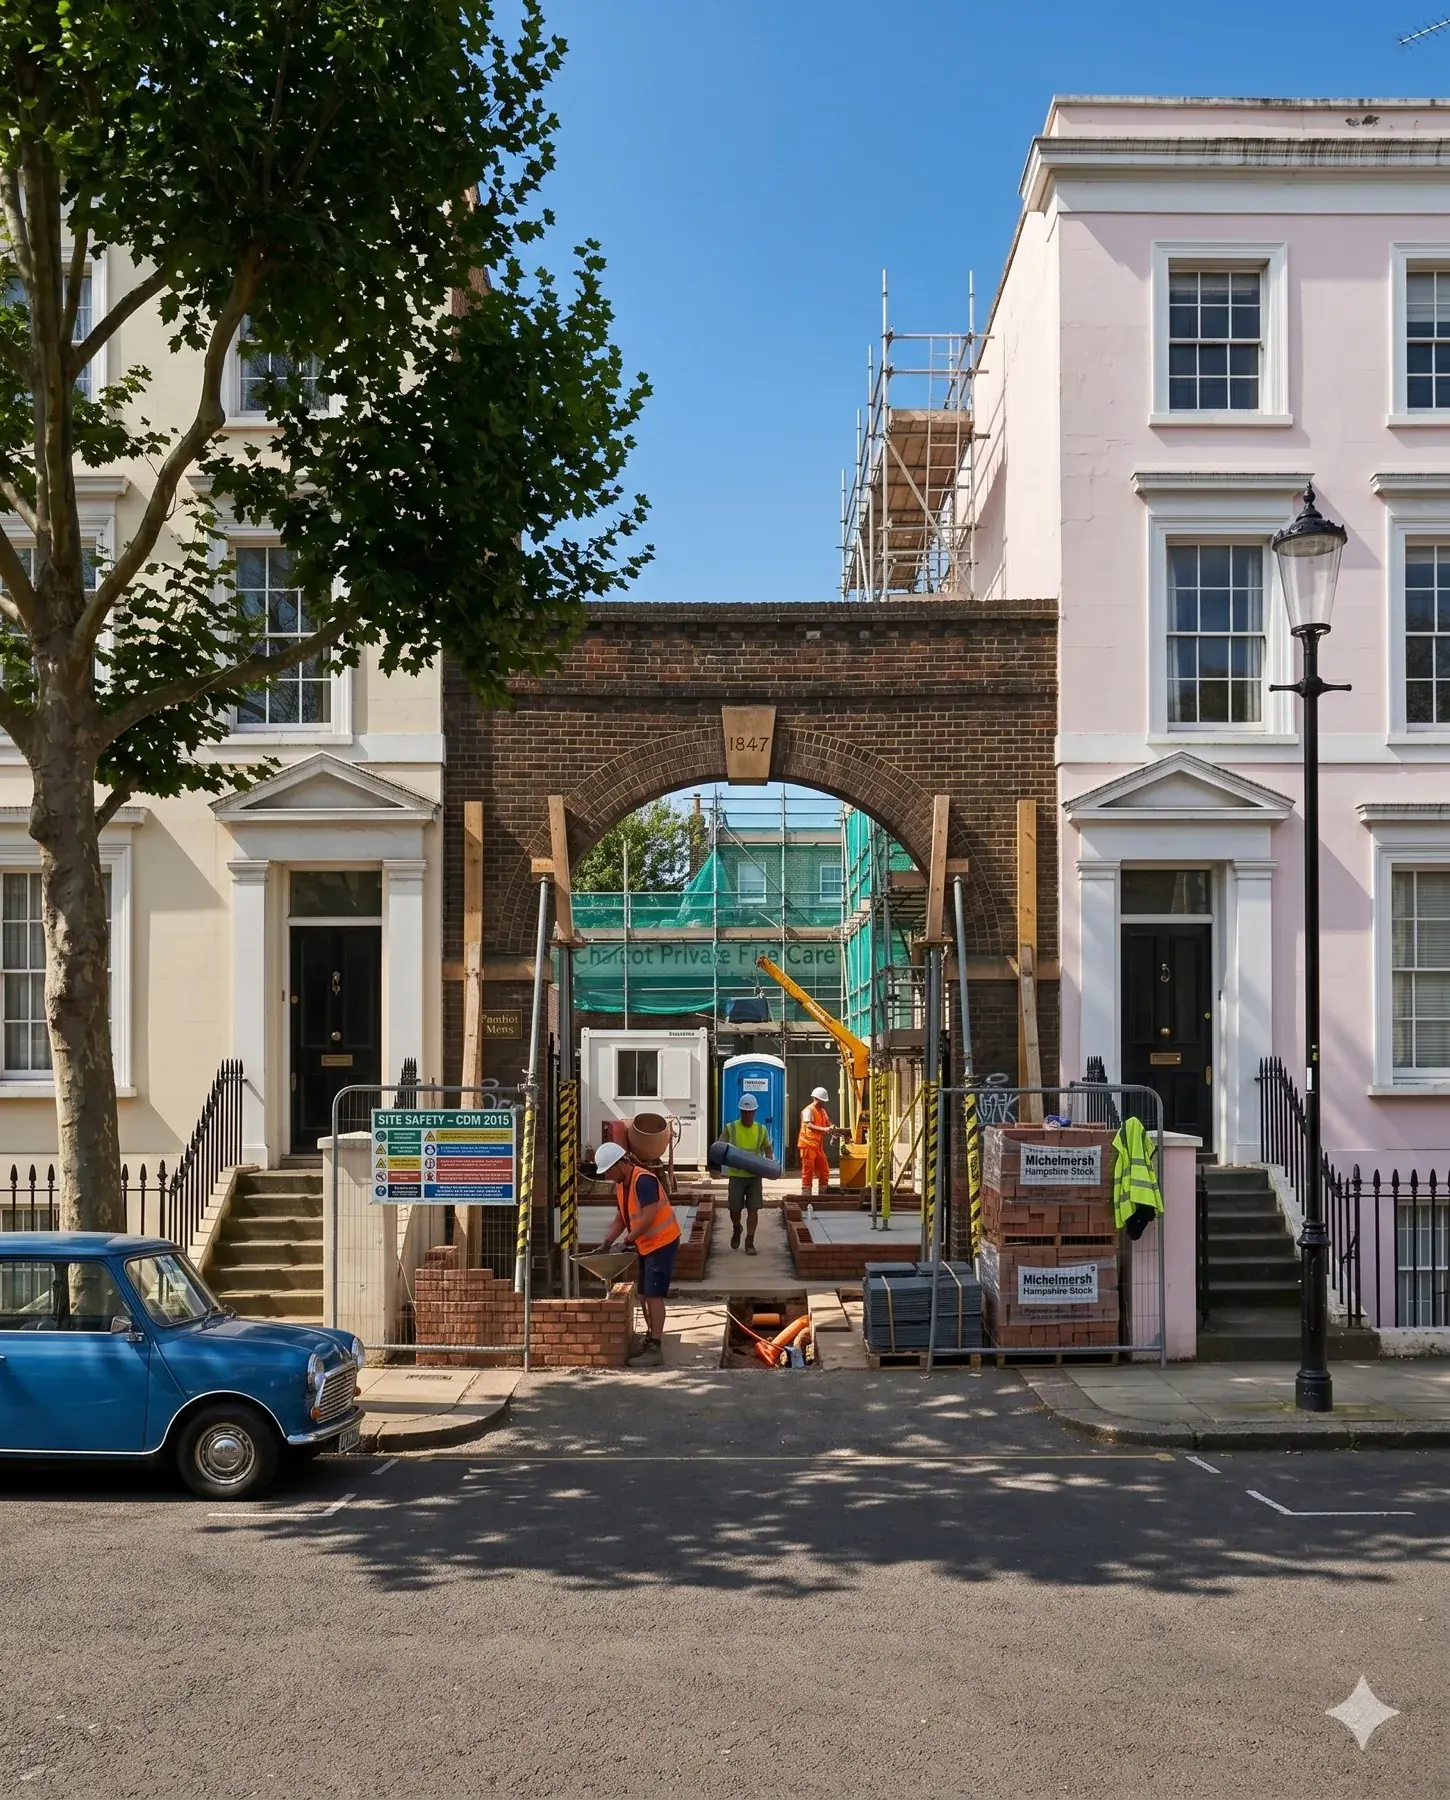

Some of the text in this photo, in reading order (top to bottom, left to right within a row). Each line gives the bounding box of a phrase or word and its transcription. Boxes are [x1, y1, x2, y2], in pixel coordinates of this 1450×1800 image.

[730, 737, 770, 752] 1847
[786, 944, 836, 965] Care
[378, 1115, 402, 1125] SITE
[405, 1115, 445, 1125] SAFETY
[456, 1115, 481, 1125] CDM
[484, 1115, 510, 1125] 2015
[1025, 1155, 1095, 1166] Michelmersh
[1025, 1167, 1095, 1177] Hampshire Stock
[1023, 1273, 1092, 1285] Michelmersh
[1023, 1286, 1093, 1296] Hampshire Stock
